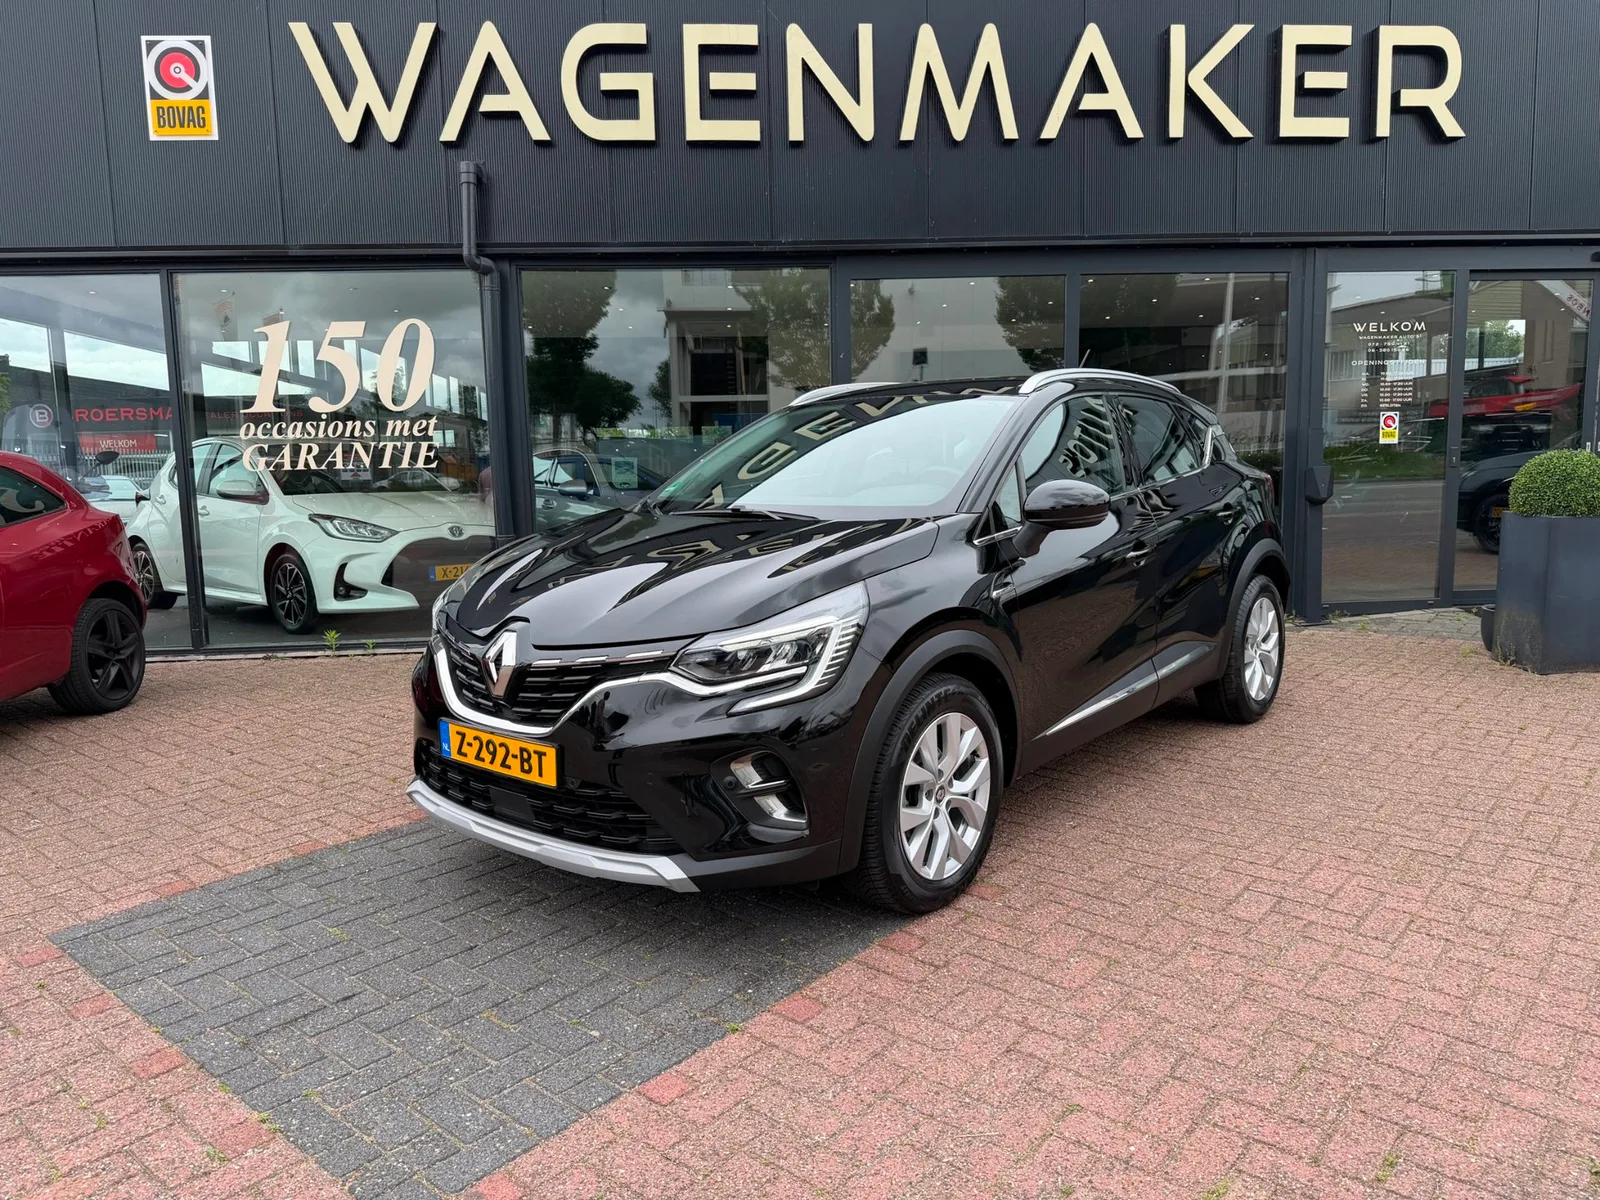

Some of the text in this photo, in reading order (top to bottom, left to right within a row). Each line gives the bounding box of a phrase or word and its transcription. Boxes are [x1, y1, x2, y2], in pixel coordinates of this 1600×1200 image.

[288, 20, 1466, 143] WAGENMAKER
[155, 105, 207, 129] BOVAG
[1353, 321, 1426, 332] WELKOM
[239, 317, 436, 414] 150
[239, 413, 438, 440] occasions met
[99, 439, 137, 448] WELKOM
[242, 441, 440, 472] GARANTIE
[455, 730, 547, 778] Z-292-BT
